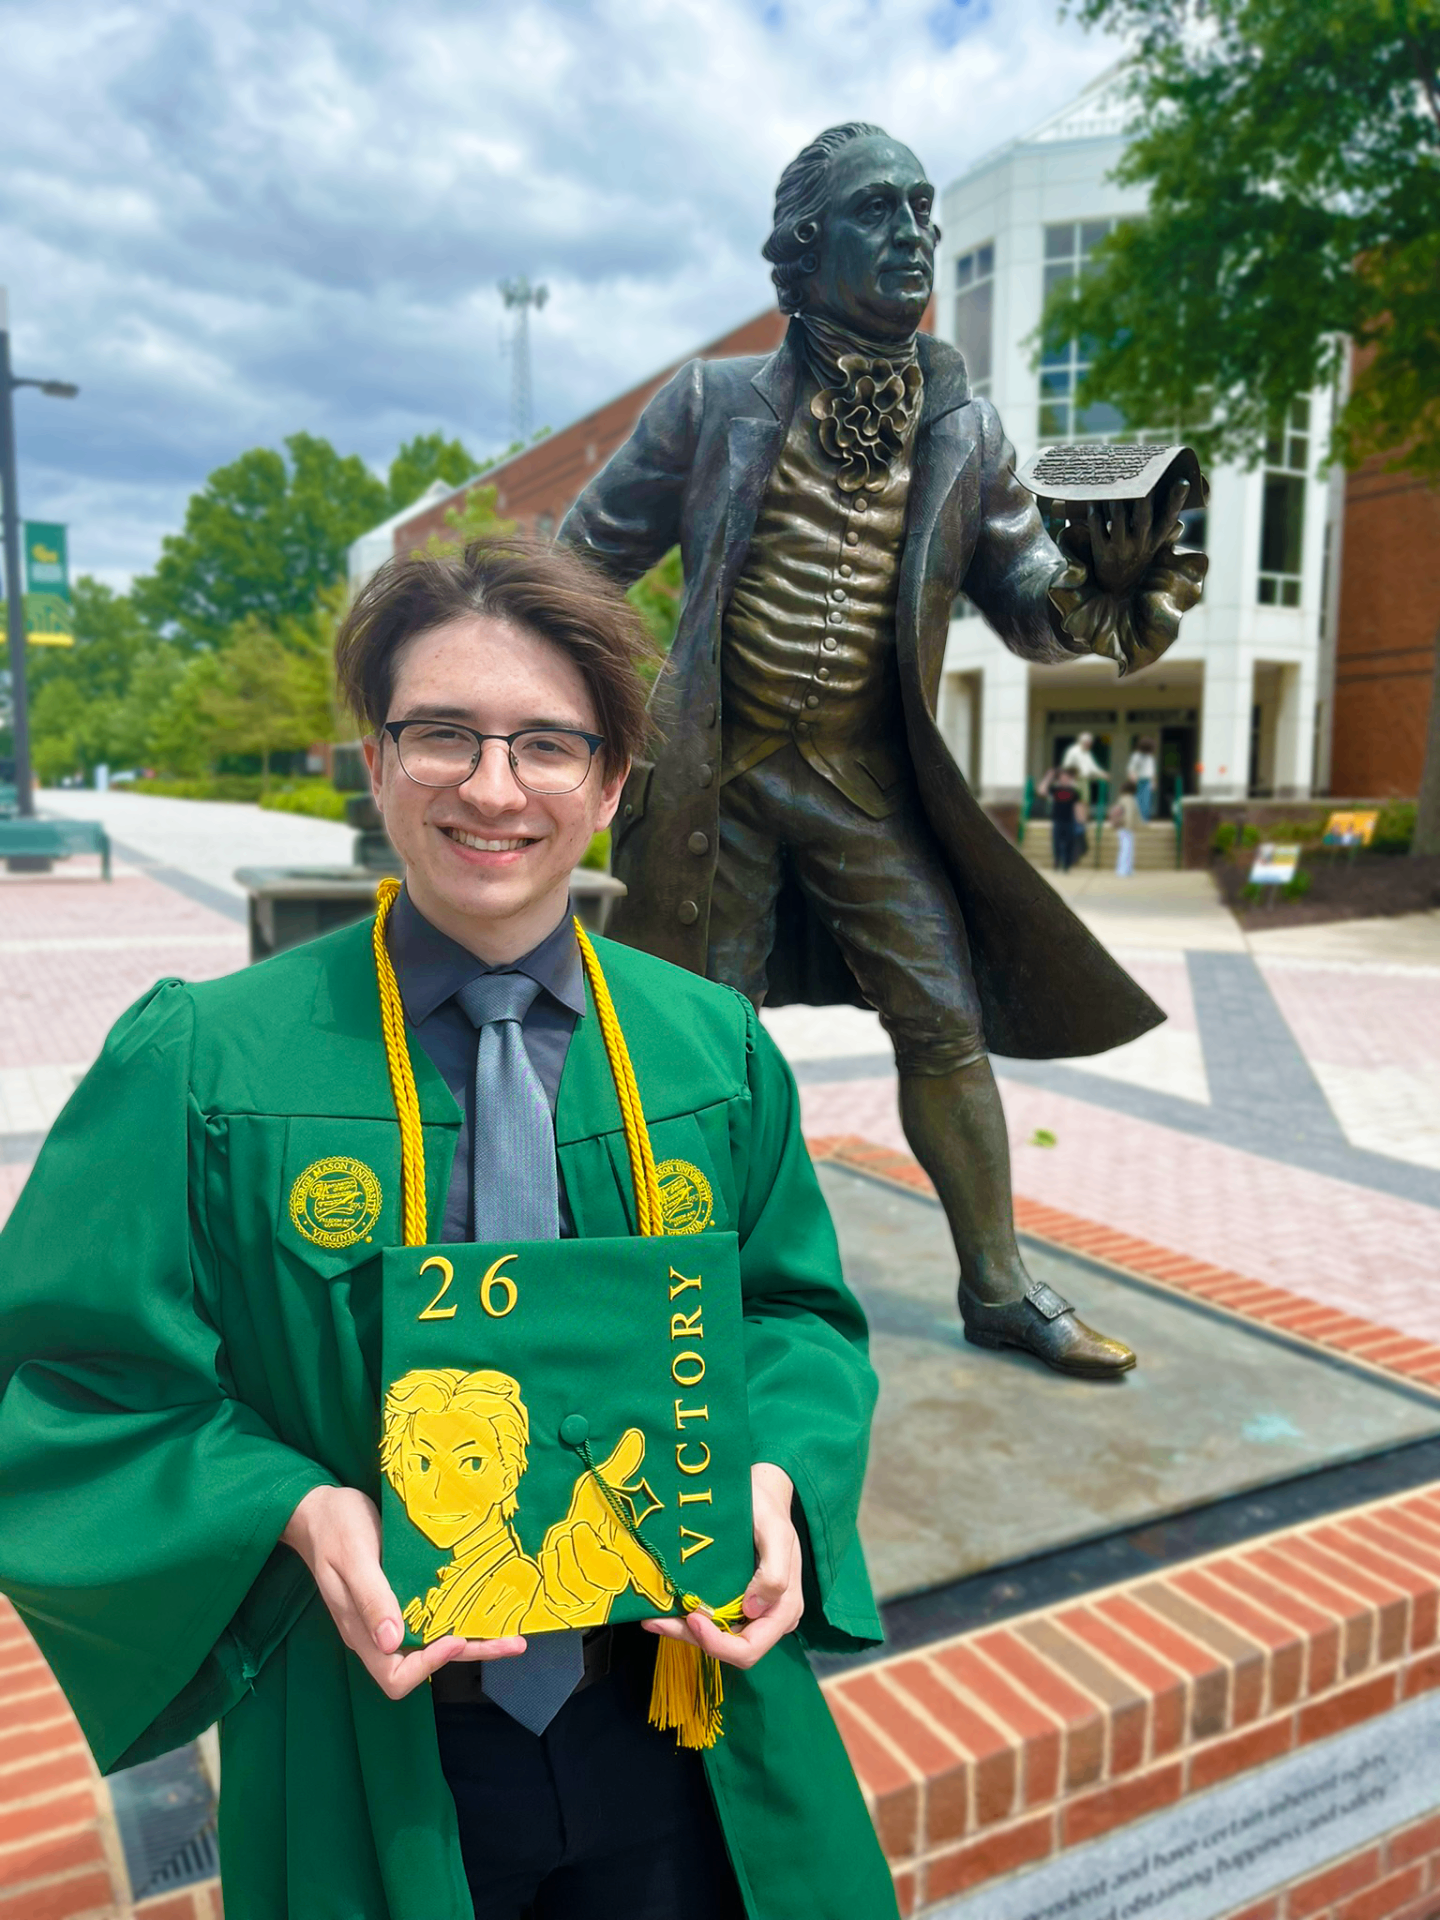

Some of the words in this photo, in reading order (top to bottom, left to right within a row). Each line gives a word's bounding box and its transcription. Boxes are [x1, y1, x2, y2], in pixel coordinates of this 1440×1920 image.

[313, 1162, 348, 1177] MASON
[313, 1228, 358, 1242] VIRGINIA
[669, 1265, 715, 1564] VICTORY
[1112, 1855, 1149, 1890] and
[1153, 1839, 1198, 1871] have
[1202, 1808, 1264, 1848] certain
